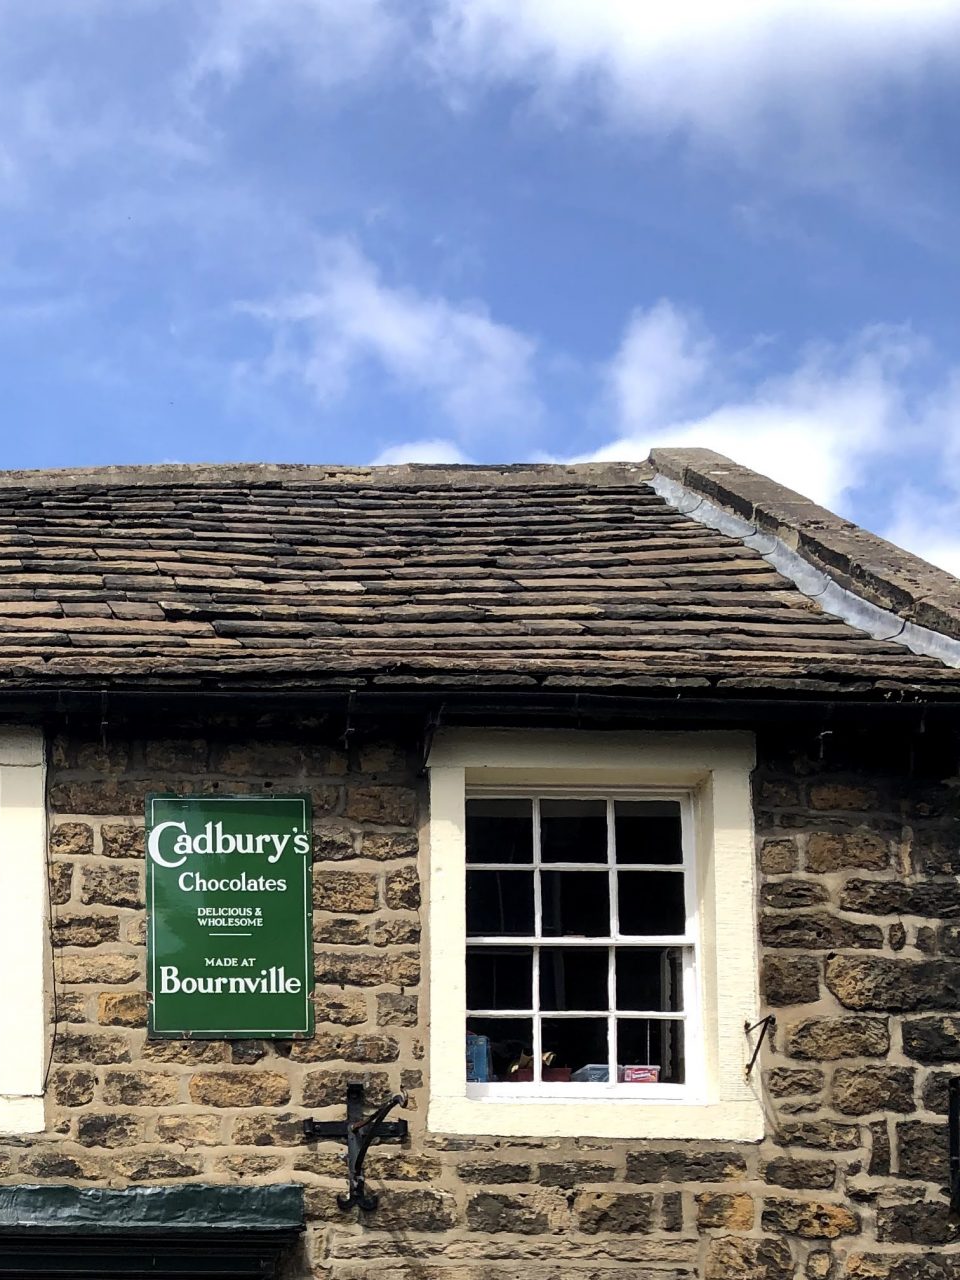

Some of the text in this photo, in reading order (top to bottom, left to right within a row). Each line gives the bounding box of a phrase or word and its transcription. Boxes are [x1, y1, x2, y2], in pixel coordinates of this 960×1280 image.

[147, 821, 310, 868] Cadbury's
[178, 872, 288, 892] Chocolates
[197, 907, 263, 917] DELICIOUS &
[197, 917, 264, 927] WHOLESOME
[204, 957, 257, 967] MADE AT
[159, 966, 302, 994] Bournville
